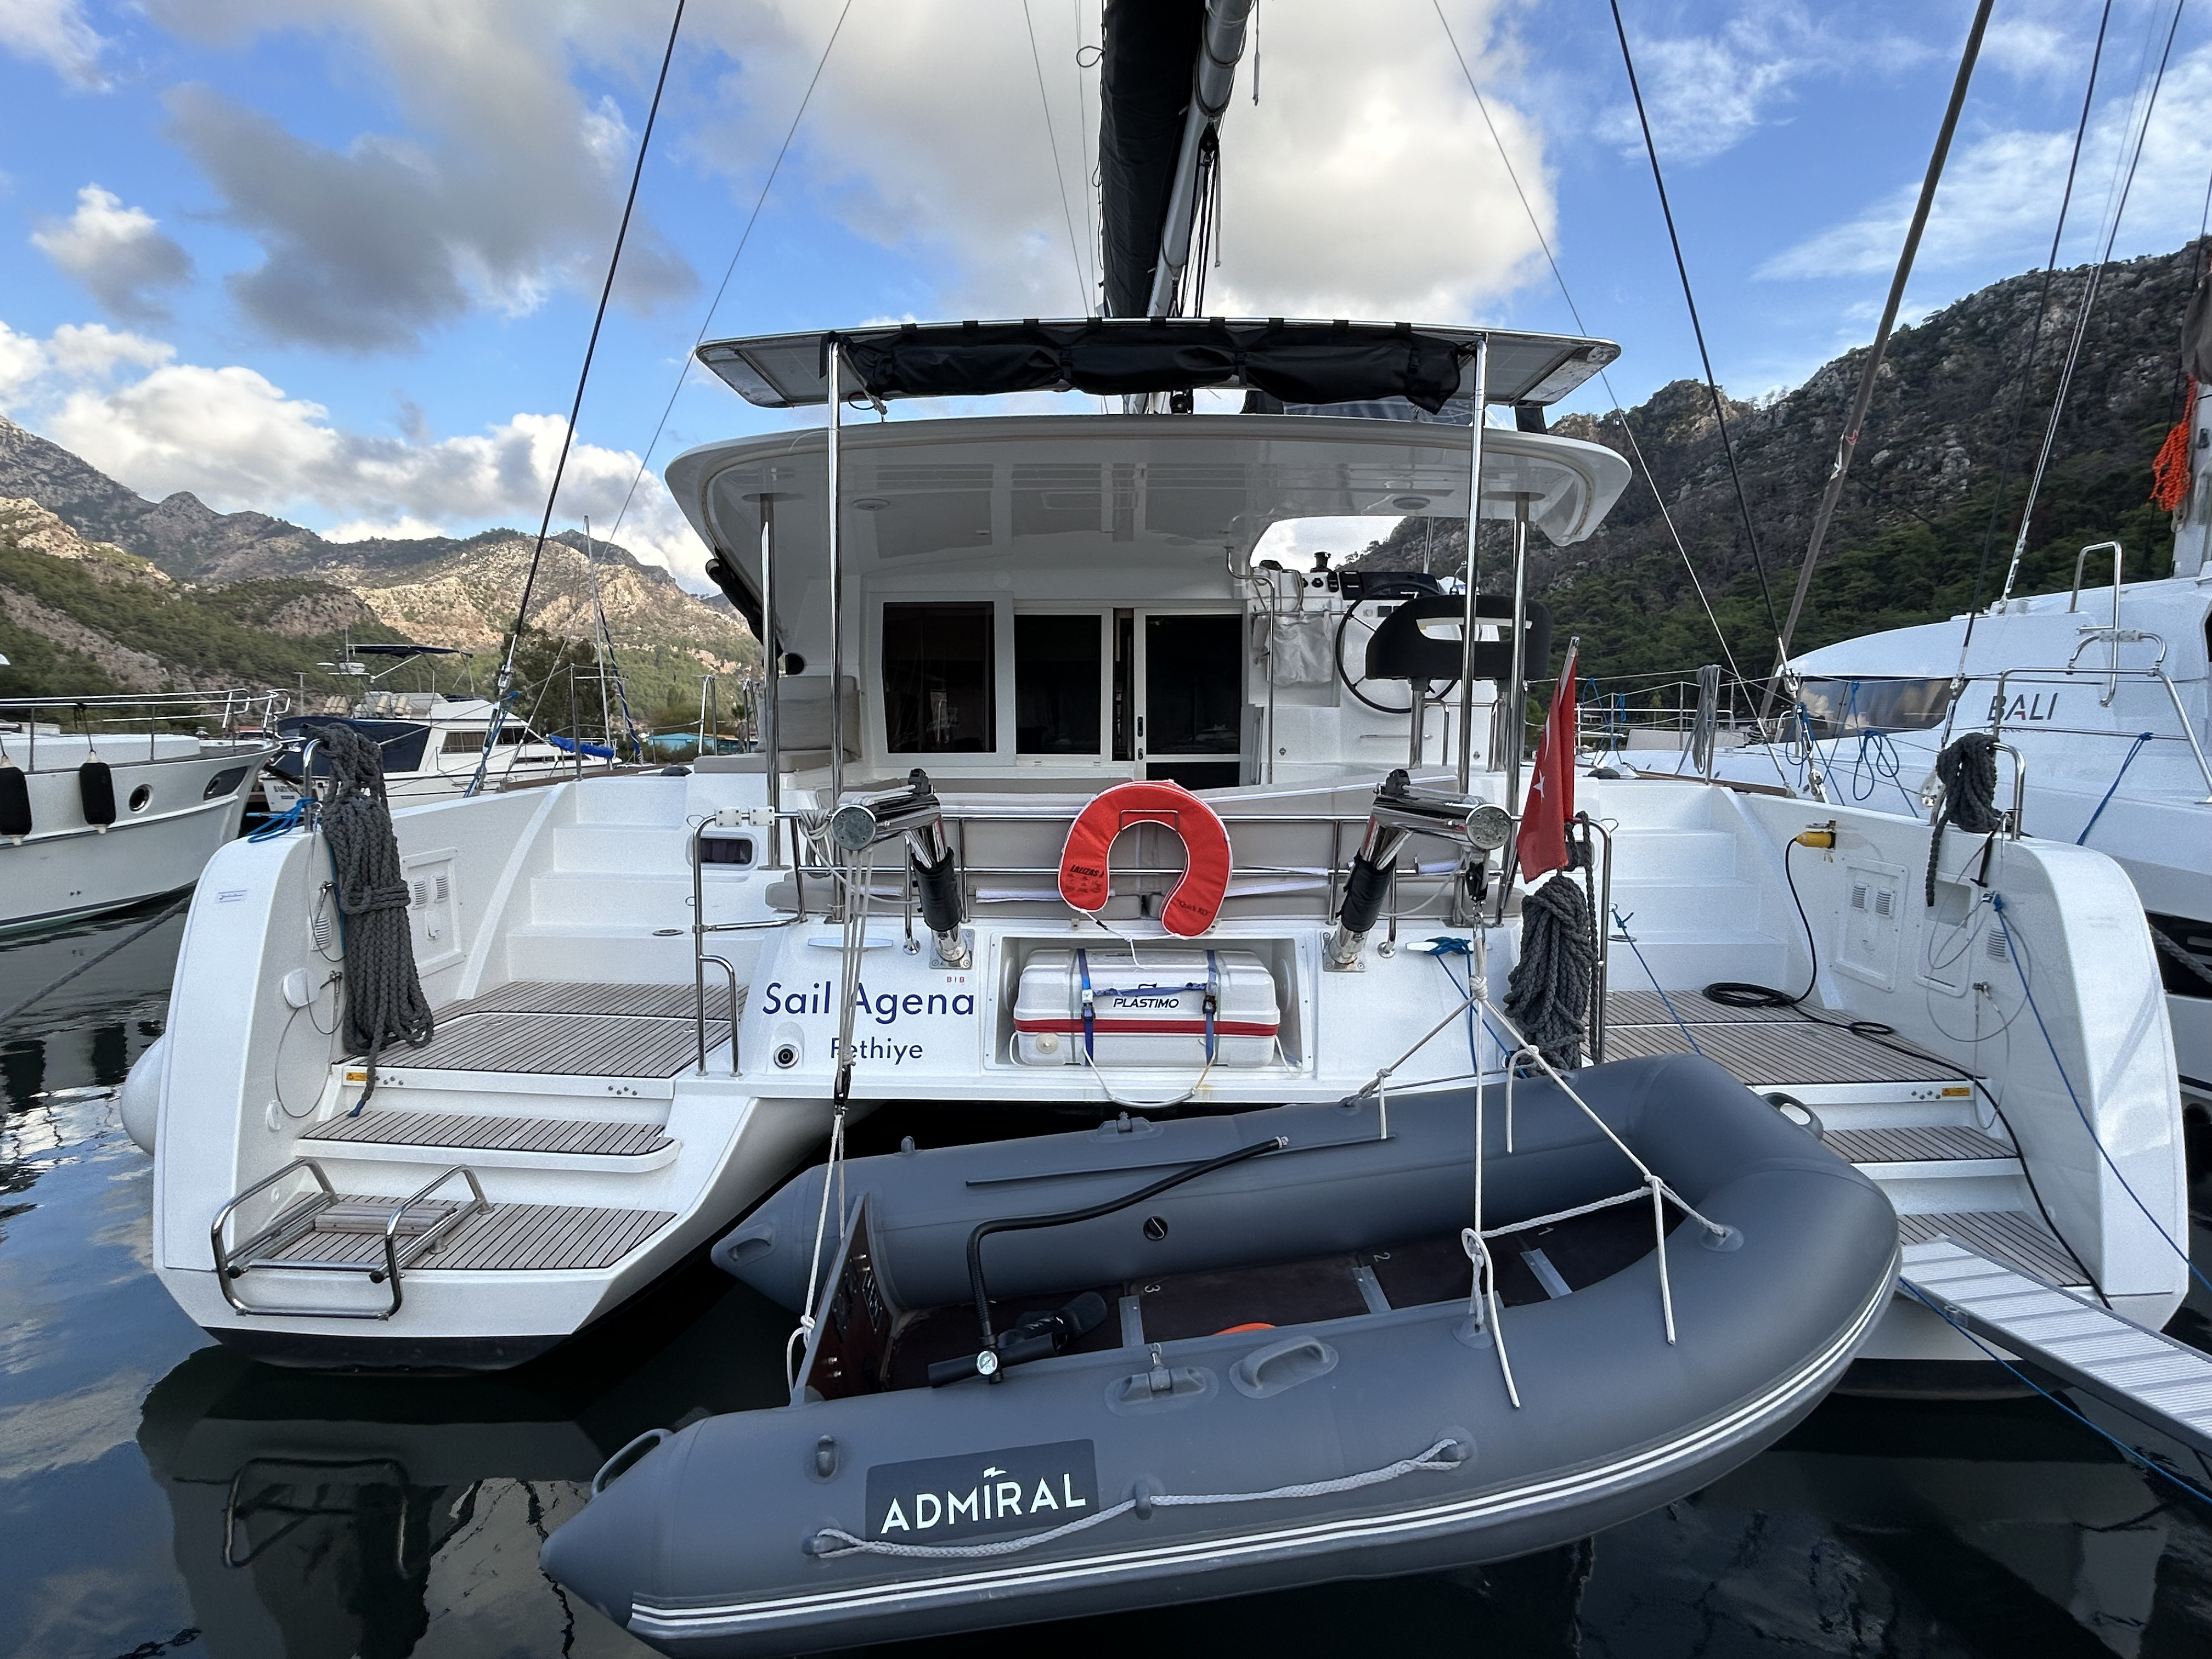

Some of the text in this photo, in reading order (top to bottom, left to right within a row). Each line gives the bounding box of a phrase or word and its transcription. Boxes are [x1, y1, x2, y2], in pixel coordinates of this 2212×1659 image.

[1987, 692, 2058, 721] BALI
[763, 981, 974, 1025] Sail Agena
[1113, 998, 1180, 1008] PLASTIMO
[1373, 1252, 1391, 1262] 2
[1144, 1284, 1161, 1293] 3
[880, 1470, 1087, 1534] ADMIRAL
